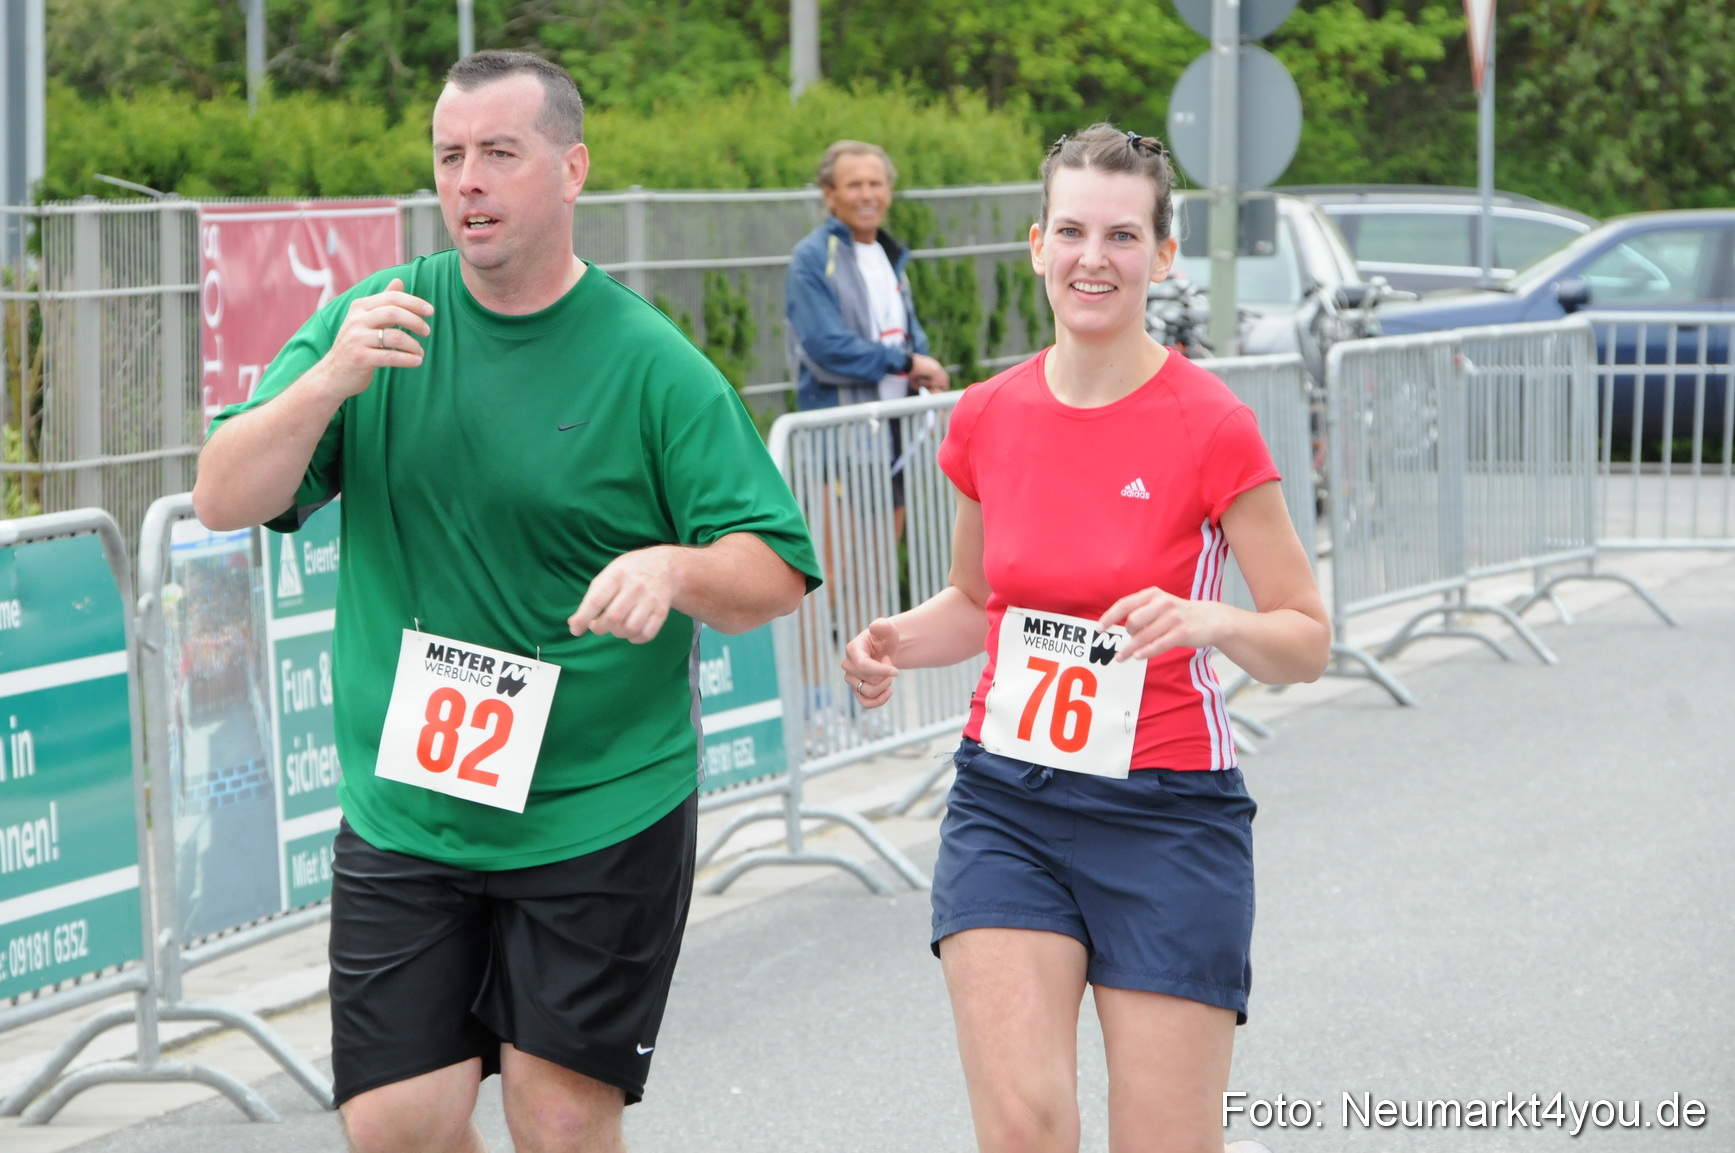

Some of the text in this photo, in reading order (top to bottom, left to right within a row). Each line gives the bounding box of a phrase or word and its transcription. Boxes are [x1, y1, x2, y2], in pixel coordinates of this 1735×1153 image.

[1121, 489, 1150, 500] adidas
[1023, 617, 1087, 644] MEYER
[1023, 634, 1085, 657] WERBUNG
[424, 660, 492, 687] WERBUNG
[426, 642, 496, 674] MEYER
[281, 658, 317, 714] Fun
[1017, 656, 1098, 753] 76
[10, 714, 35, 779] in
[416, 687, 514, 787] 82
[292, 851, 318, 889] Miet
[9, 929, 51, 978] 09181
[54, 919, 89, 964] 6352
